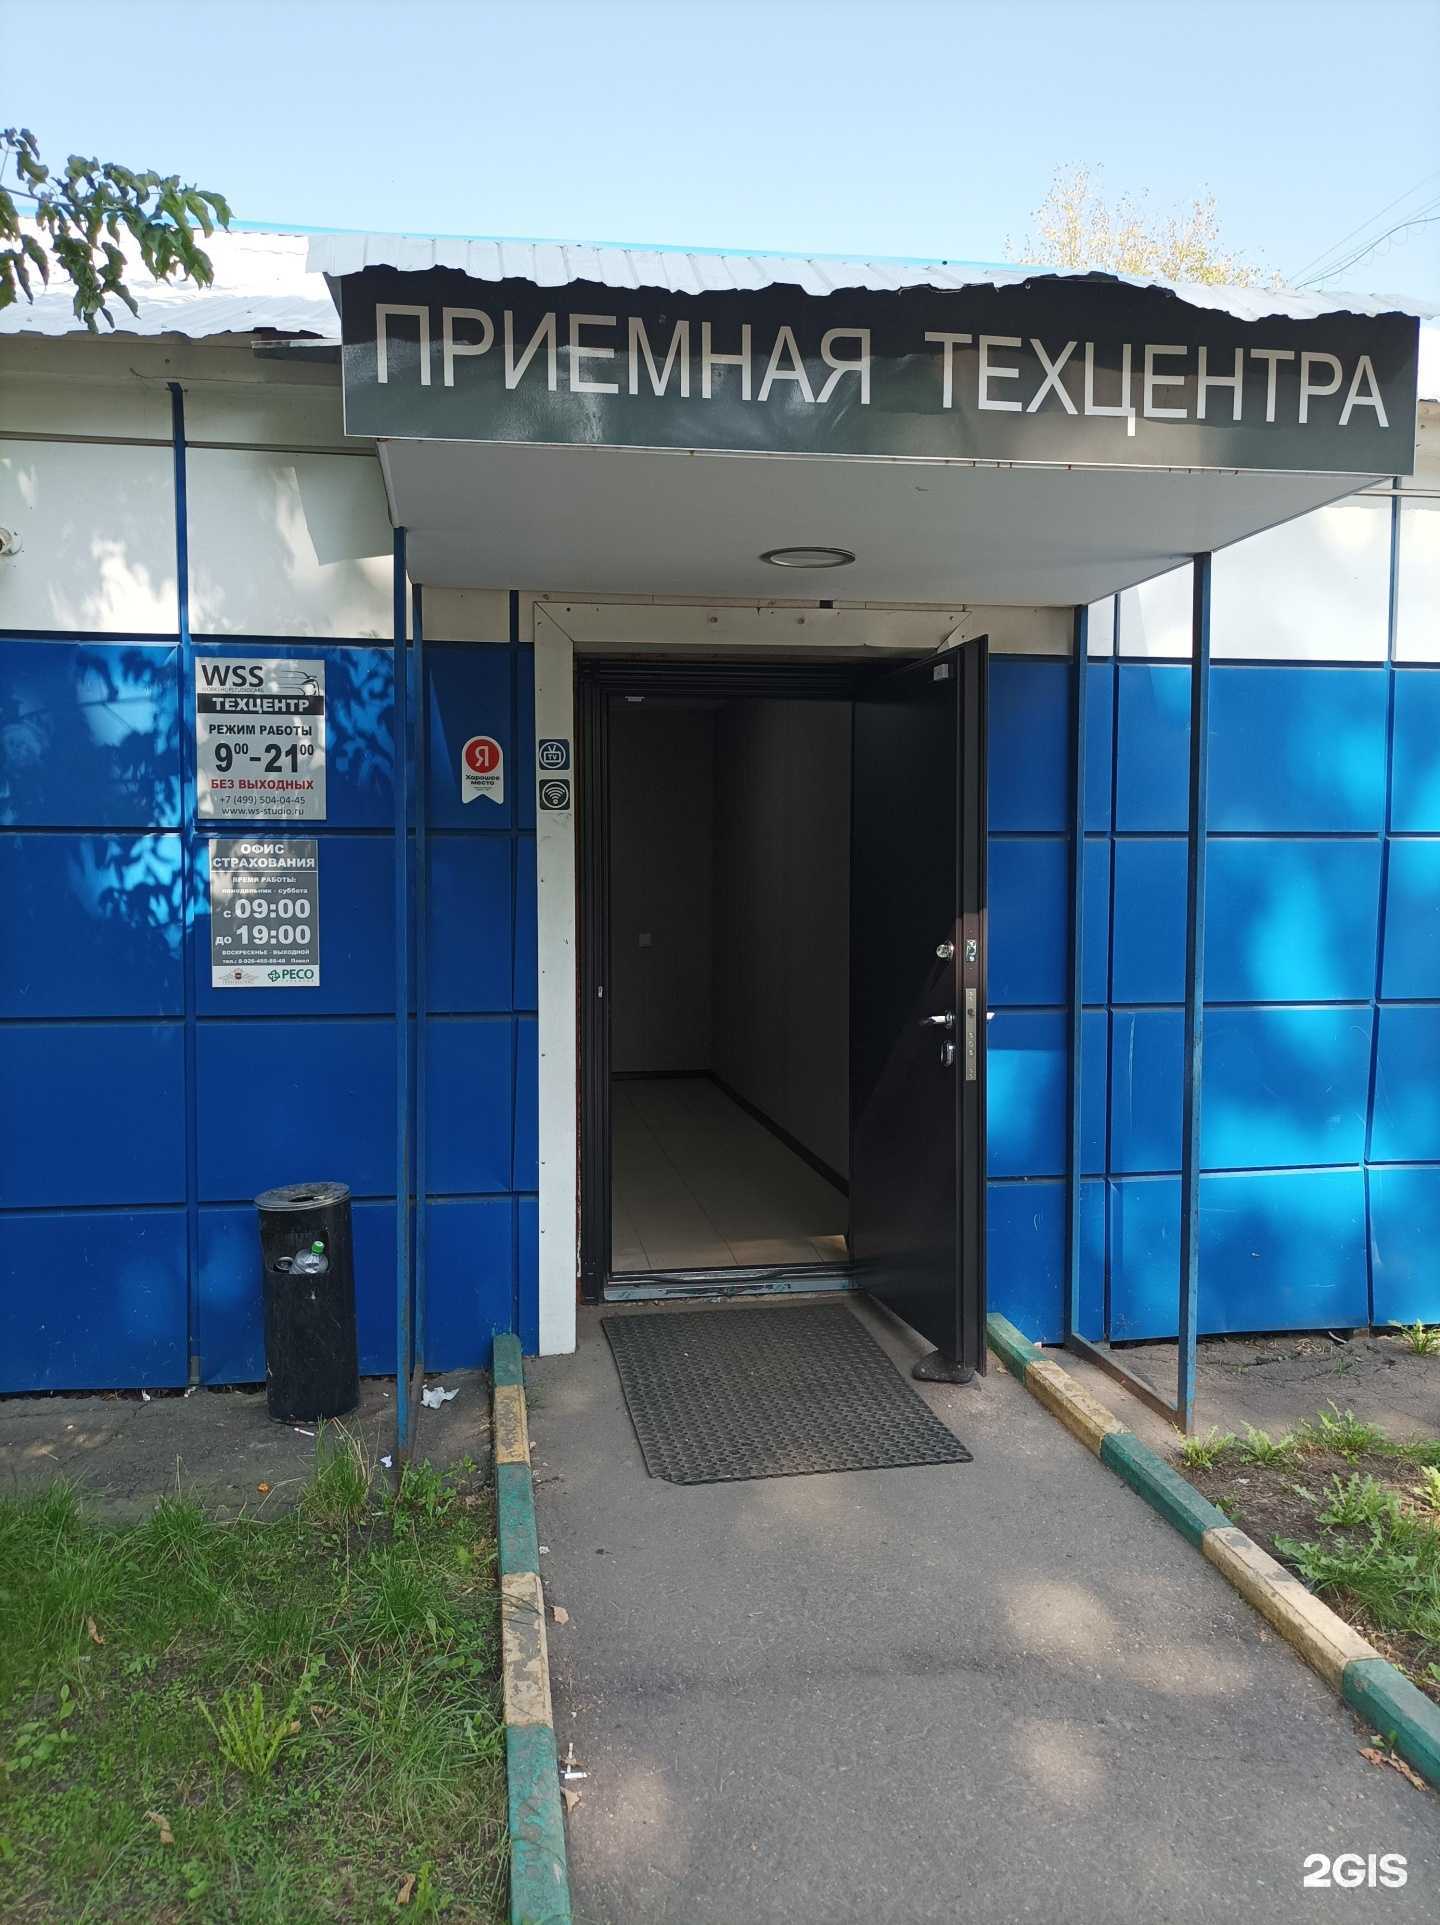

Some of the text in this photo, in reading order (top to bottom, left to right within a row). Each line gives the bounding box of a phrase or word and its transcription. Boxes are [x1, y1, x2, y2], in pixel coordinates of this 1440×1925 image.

[376, 303, 1390, 437] ПРИЕМНАЯ ТЕХЦЕНТРА
[201, 664, 264, 687] WSS
[212, 697, 310, 714] ТЕХЦЕНТР
[209, 724, 312, 736] РЕЖИМ РАБОТЫ
[475, 745, 489, 767] Я
[211, 779, 314, 791] БЕЗ ВЫХОДНЫХ
[233, 795, 257, 805] (499)
[259, 796, 306, 805] 504-04-45
[221, 806, 304, 816] www.ws-studio.ru
[240, 844, 285, 854] ОФИС
[213, 858, 315, 868] СТРАХОВАНИЯ
[235, 899, 311, 919] 09:00
[215, 925, 311, 946] до 19:00
[282, 969, 314, 980] РЕСО
